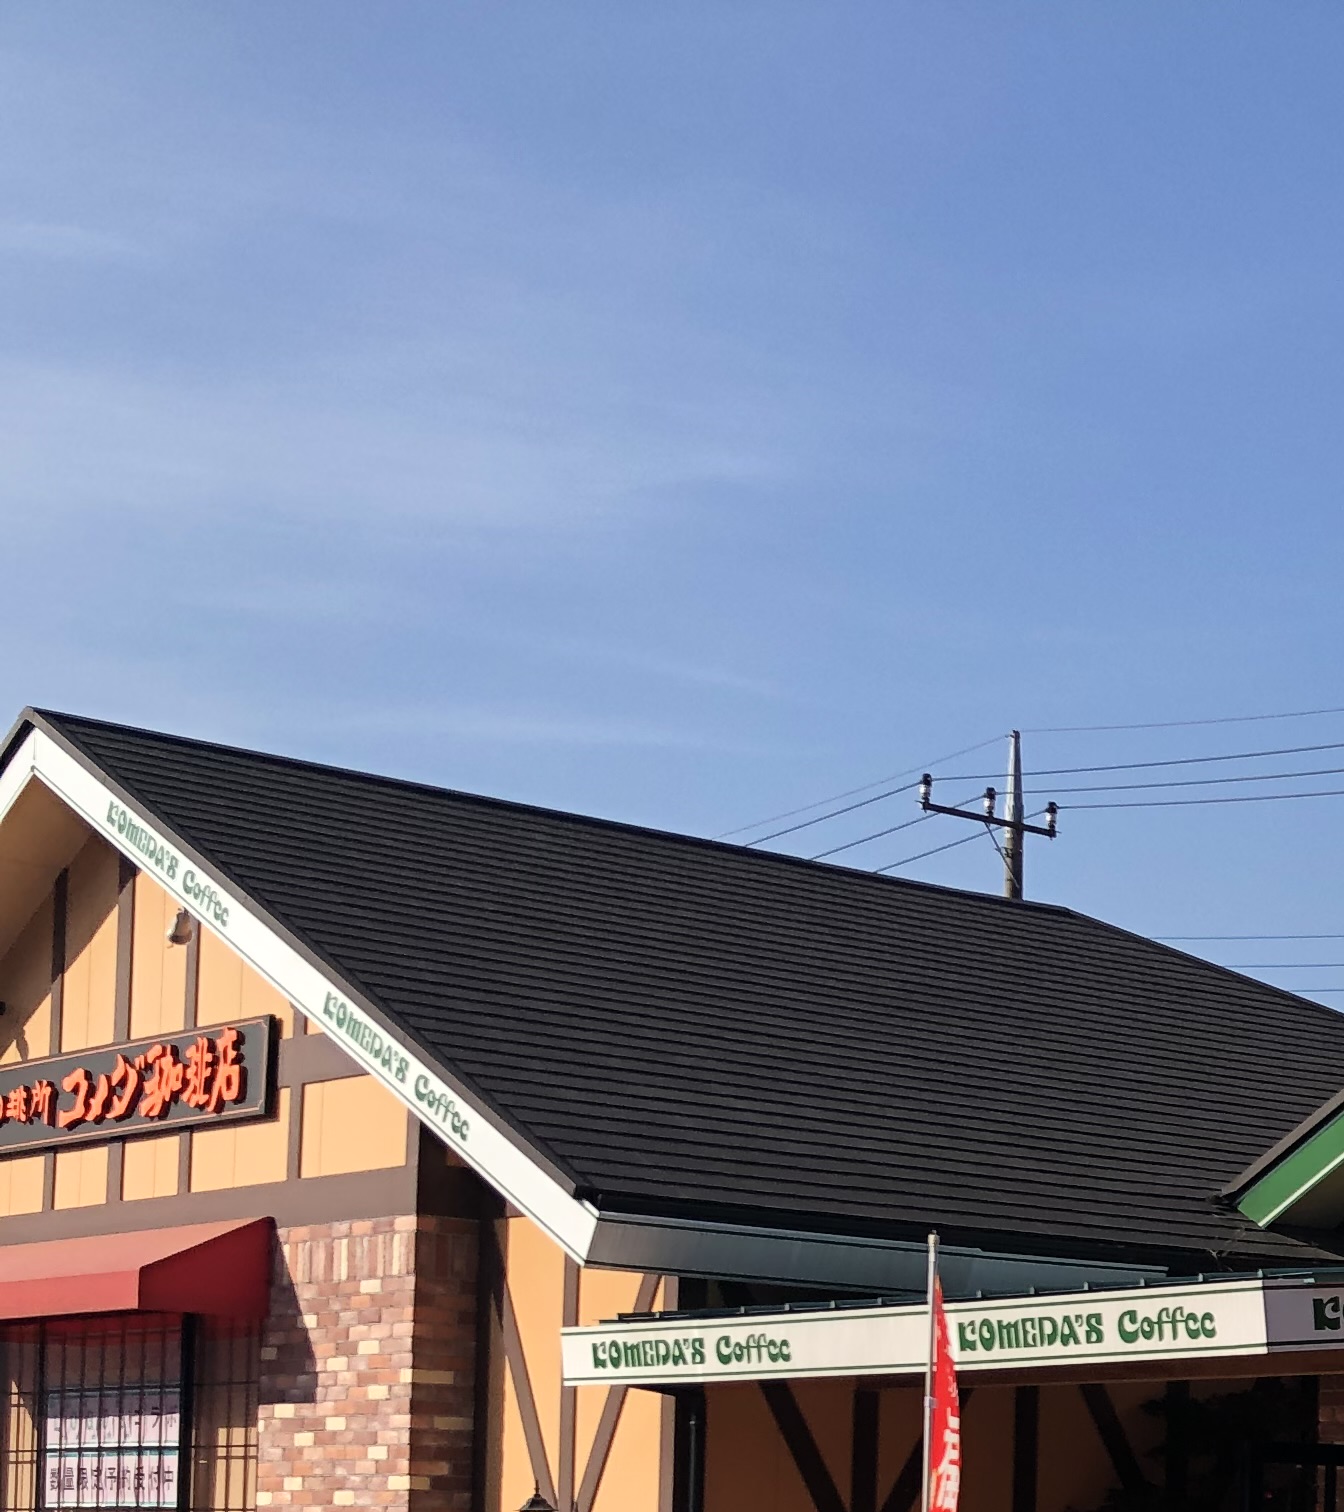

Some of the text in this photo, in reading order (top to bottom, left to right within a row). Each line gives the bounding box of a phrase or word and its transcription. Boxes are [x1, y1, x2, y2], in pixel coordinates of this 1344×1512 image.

[106, 800, 229, 927] KOMEDA'S Coffee
[323, 991, 470, 1142] KOMEDA'S Coffee
[592, 1334, 792, 1368] KOMEDA'S Coffee
[958, 1307, 1217, 1351] KOMEDA'S Coffee
